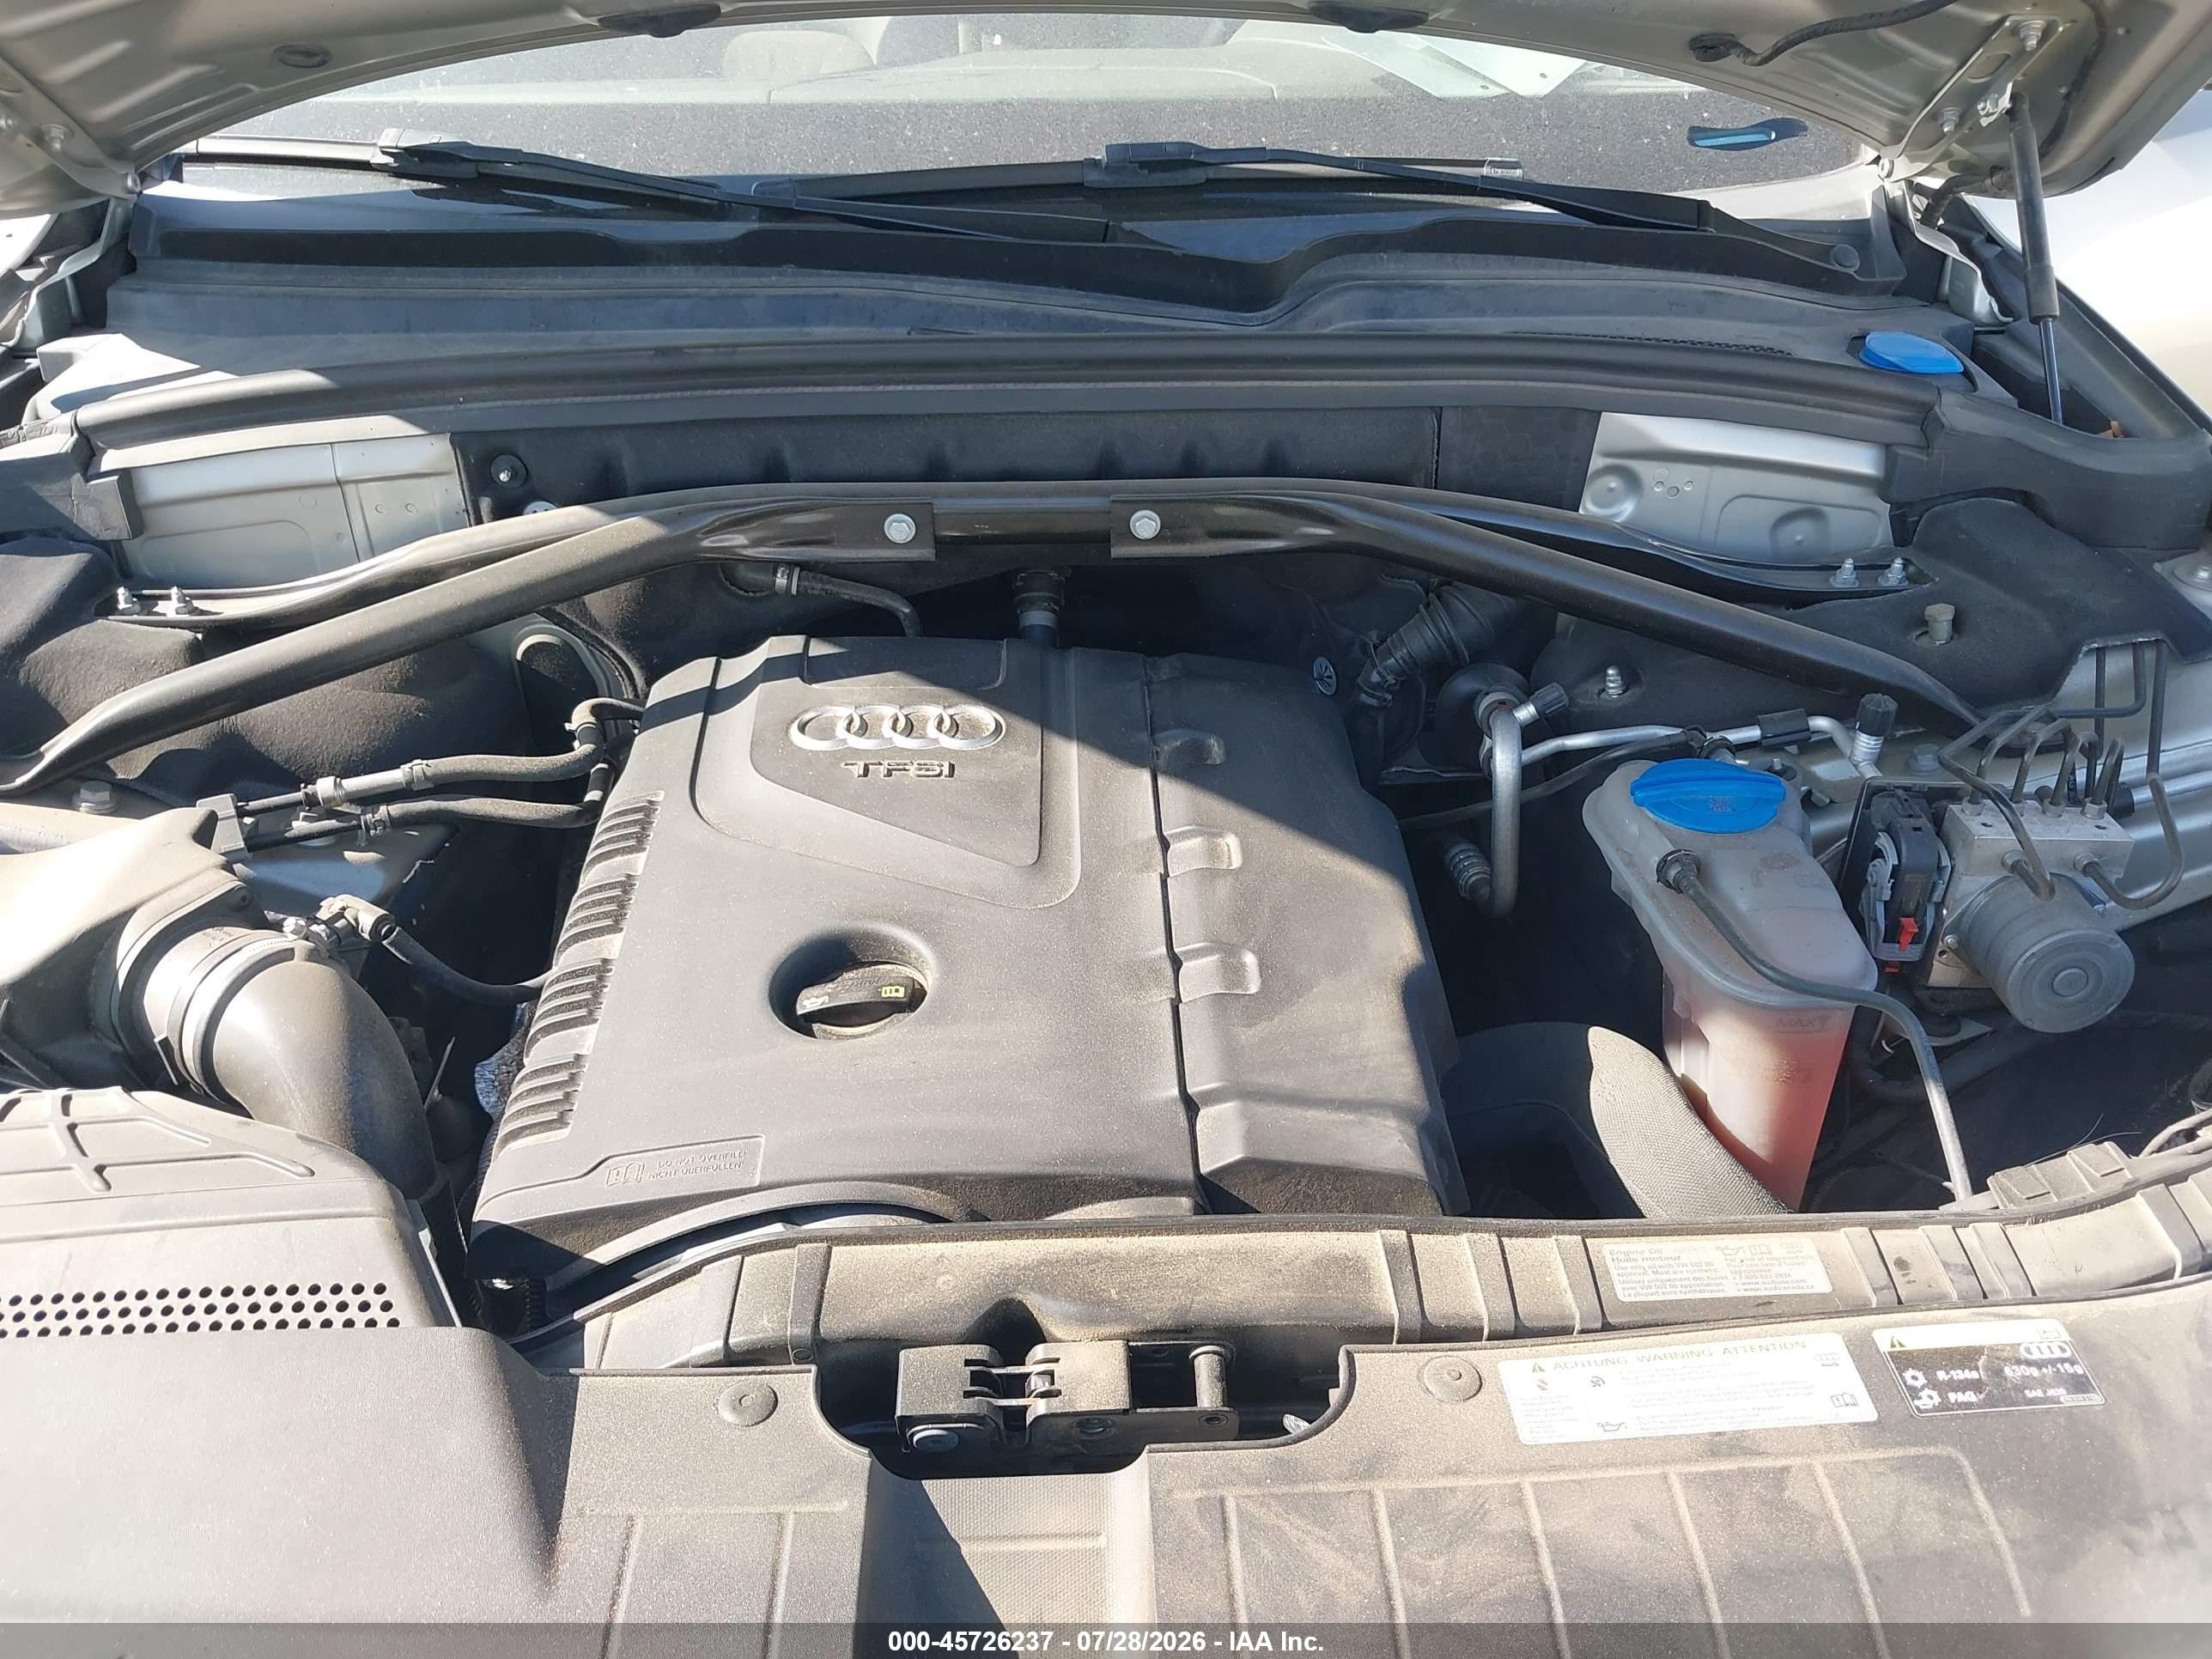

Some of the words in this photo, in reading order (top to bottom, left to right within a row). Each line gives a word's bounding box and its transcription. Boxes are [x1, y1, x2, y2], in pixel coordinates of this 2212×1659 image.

[842, 761, 955, 778] TFSI
[659, 1159, 673, 1169] DO
[676, 1156, 695, 1167] NOT
[647, 1169, 677, 1181] NICHT
[1630, 1263, 1646, 1272] only
[1647, 1277, 1691, 1285] uniquement
[1633, 1290, 1660, 1298] plupart
[1553, 1357, 1628, 1370] ACHTUNG
[1636, 1348, 1713, 1364] WARNING
[1723, 1341, 1807, 1356] ATTENTION
